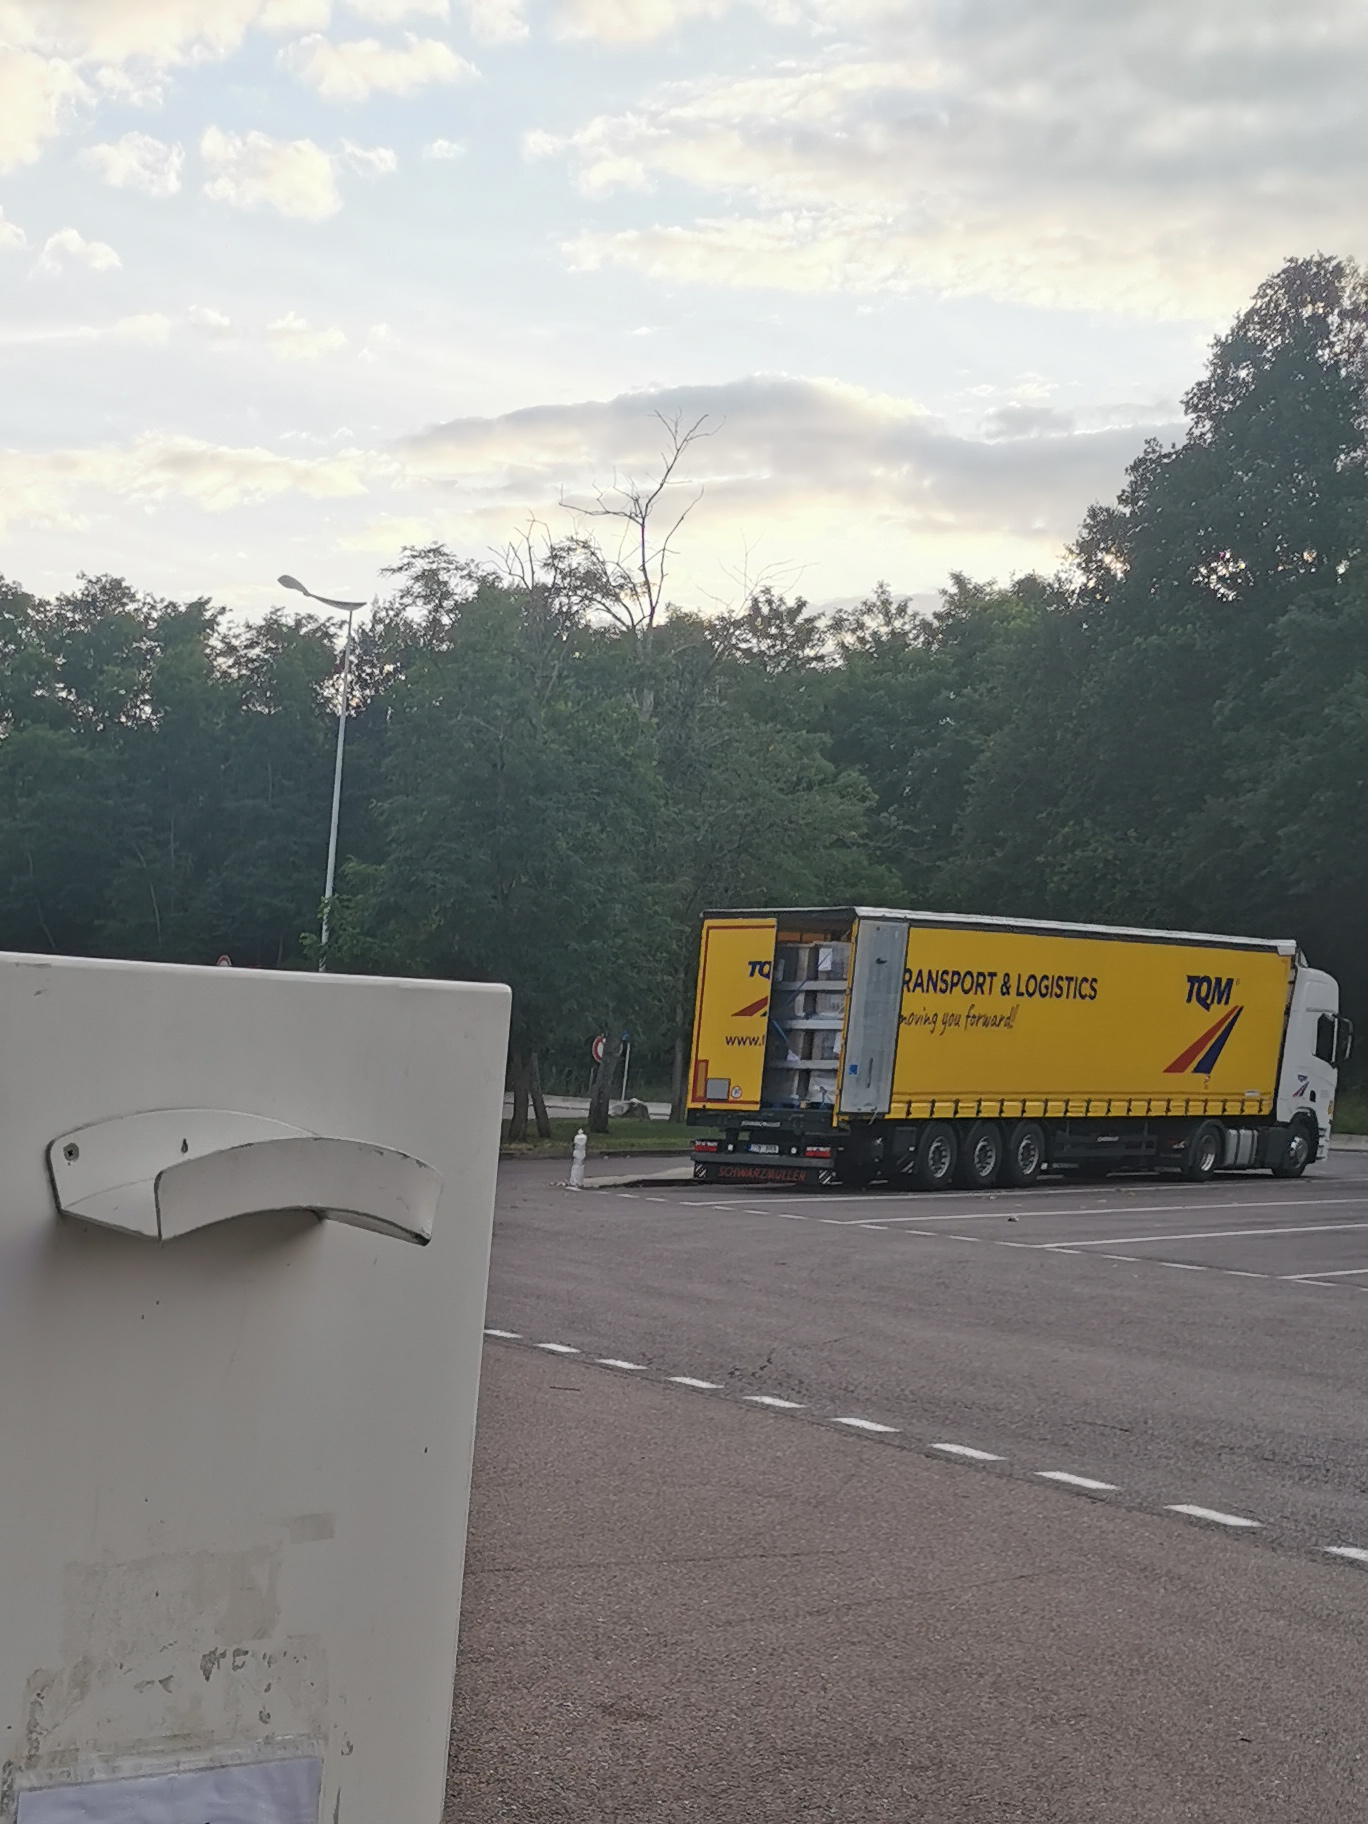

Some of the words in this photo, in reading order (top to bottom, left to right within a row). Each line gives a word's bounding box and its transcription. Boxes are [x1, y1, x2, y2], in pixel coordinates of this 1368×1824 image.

[1000, 972, 1012, 997] &
[1016, 973, 1099, 1001] LOGISTICS
[1185, 974, 1235, 1012] TQM
[939, 1011, 963, 1036] you
